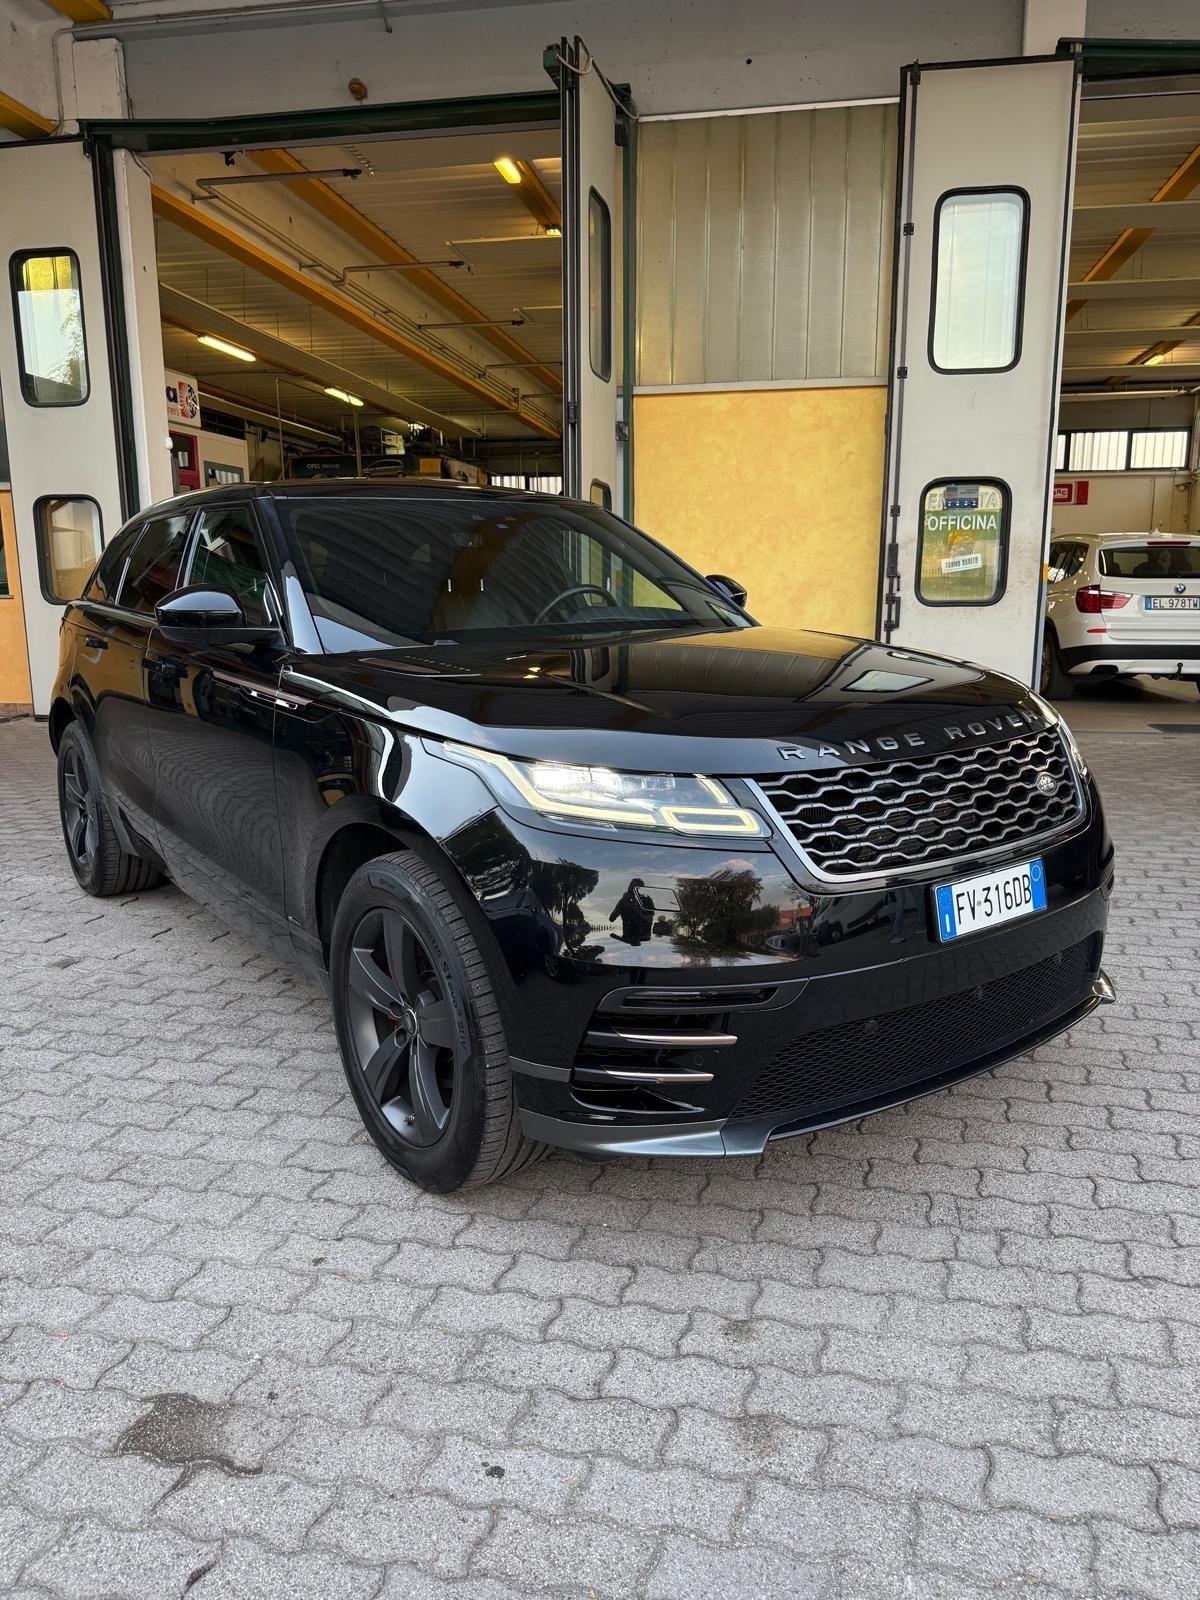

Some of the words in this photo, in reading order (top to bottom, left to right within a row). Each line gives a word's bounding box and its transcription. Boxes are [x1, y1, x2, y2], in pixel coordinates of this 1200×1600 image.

[927, 514, 997, 531] OFFICINA
[1152, 598, 1164, 608] EL
[1168, 598, 1198, 608] 978TW
[777, 732, 926, 760] RANGE
[943, 709, 1040, 741] ROVER
[955, 889, 976, 925] FV
[982, 873, 1032, 917] 316DB
